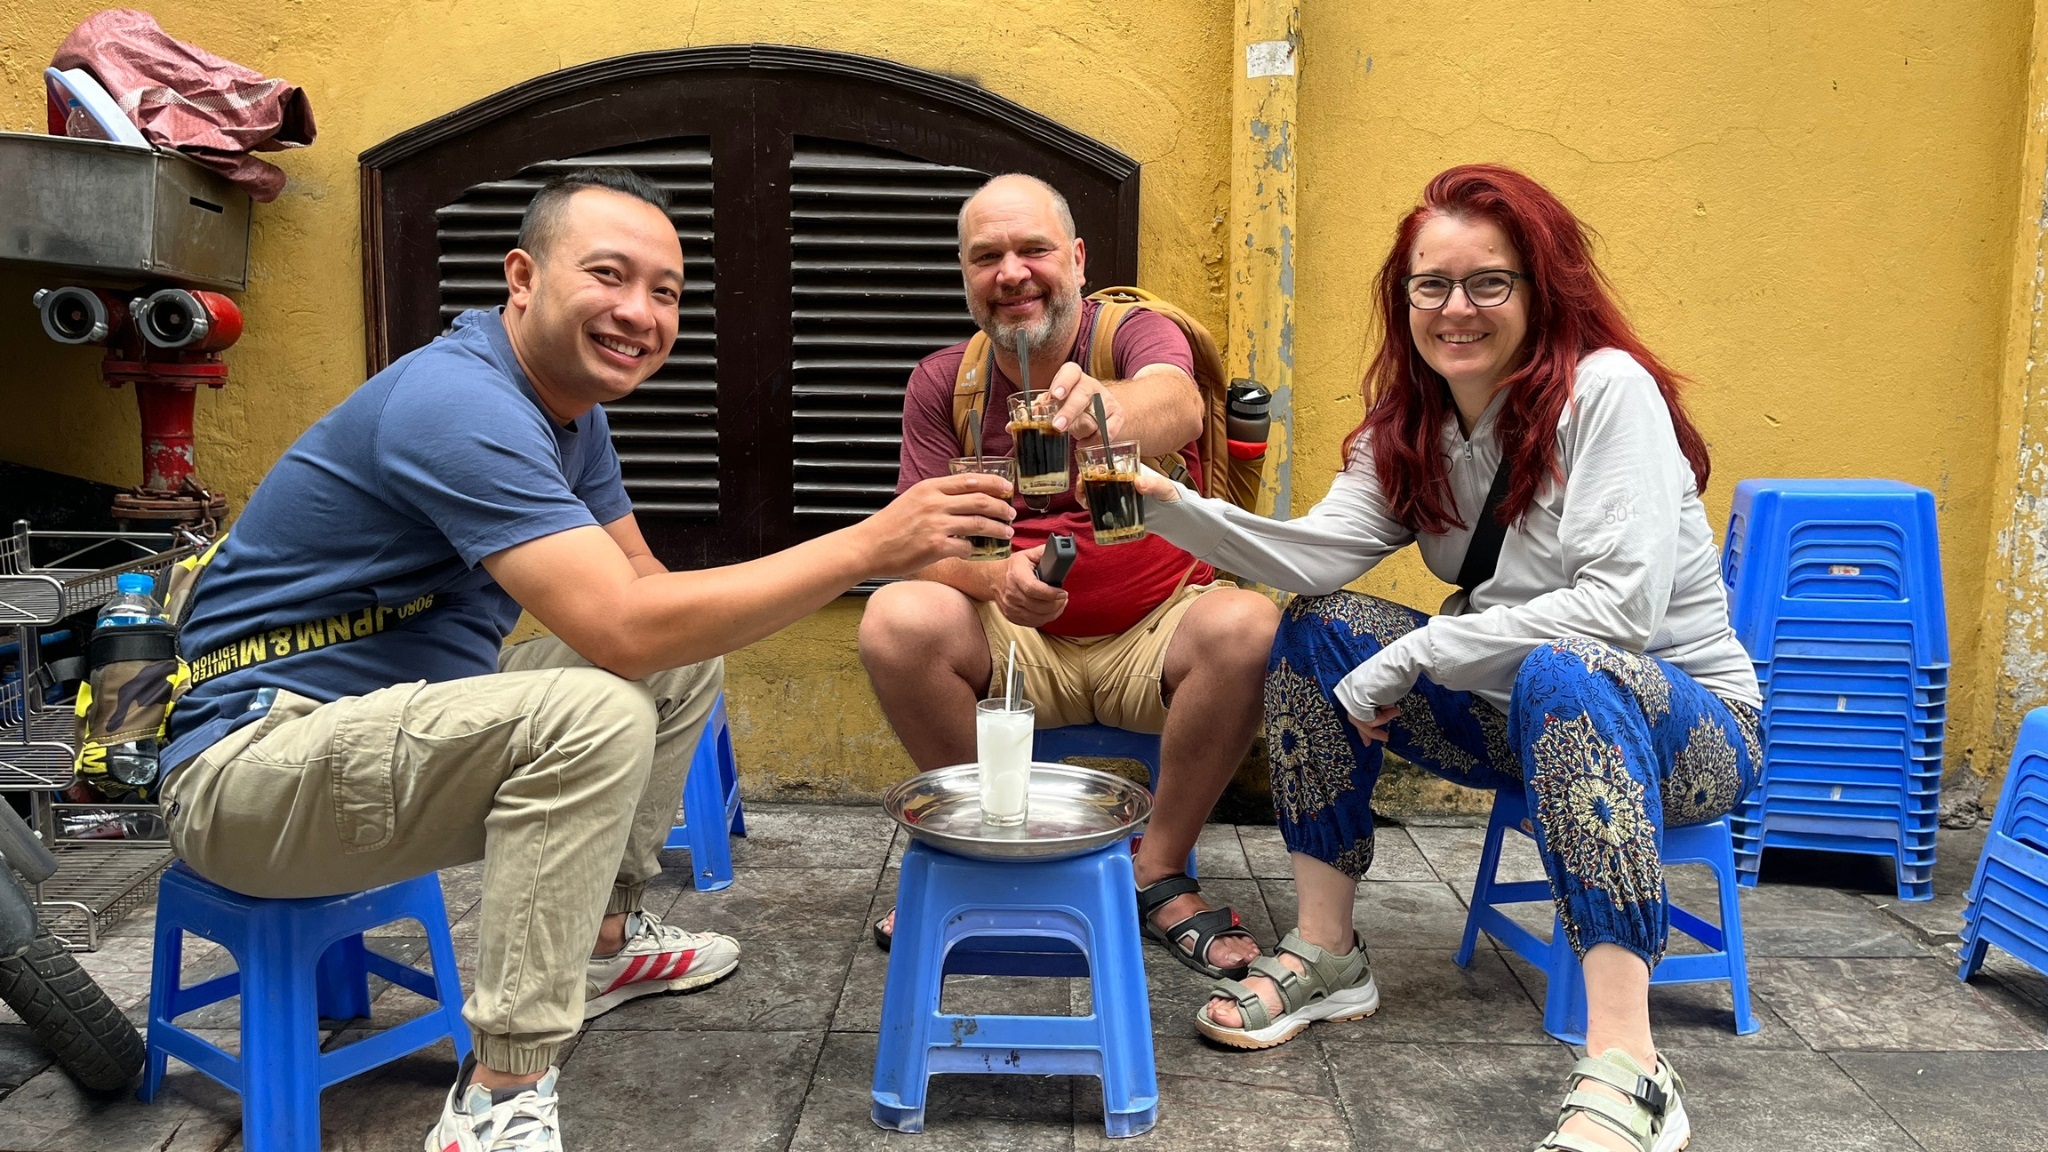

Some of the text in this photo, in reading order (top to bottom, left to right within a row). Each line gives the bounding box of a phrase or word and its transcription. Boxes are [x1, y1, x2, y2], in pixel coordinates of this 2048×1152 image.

[1604, 505, 1640, 525] 50+
[192, 643, 237, 672] EDITION
[192, 655, 239, 683] LIMITED
